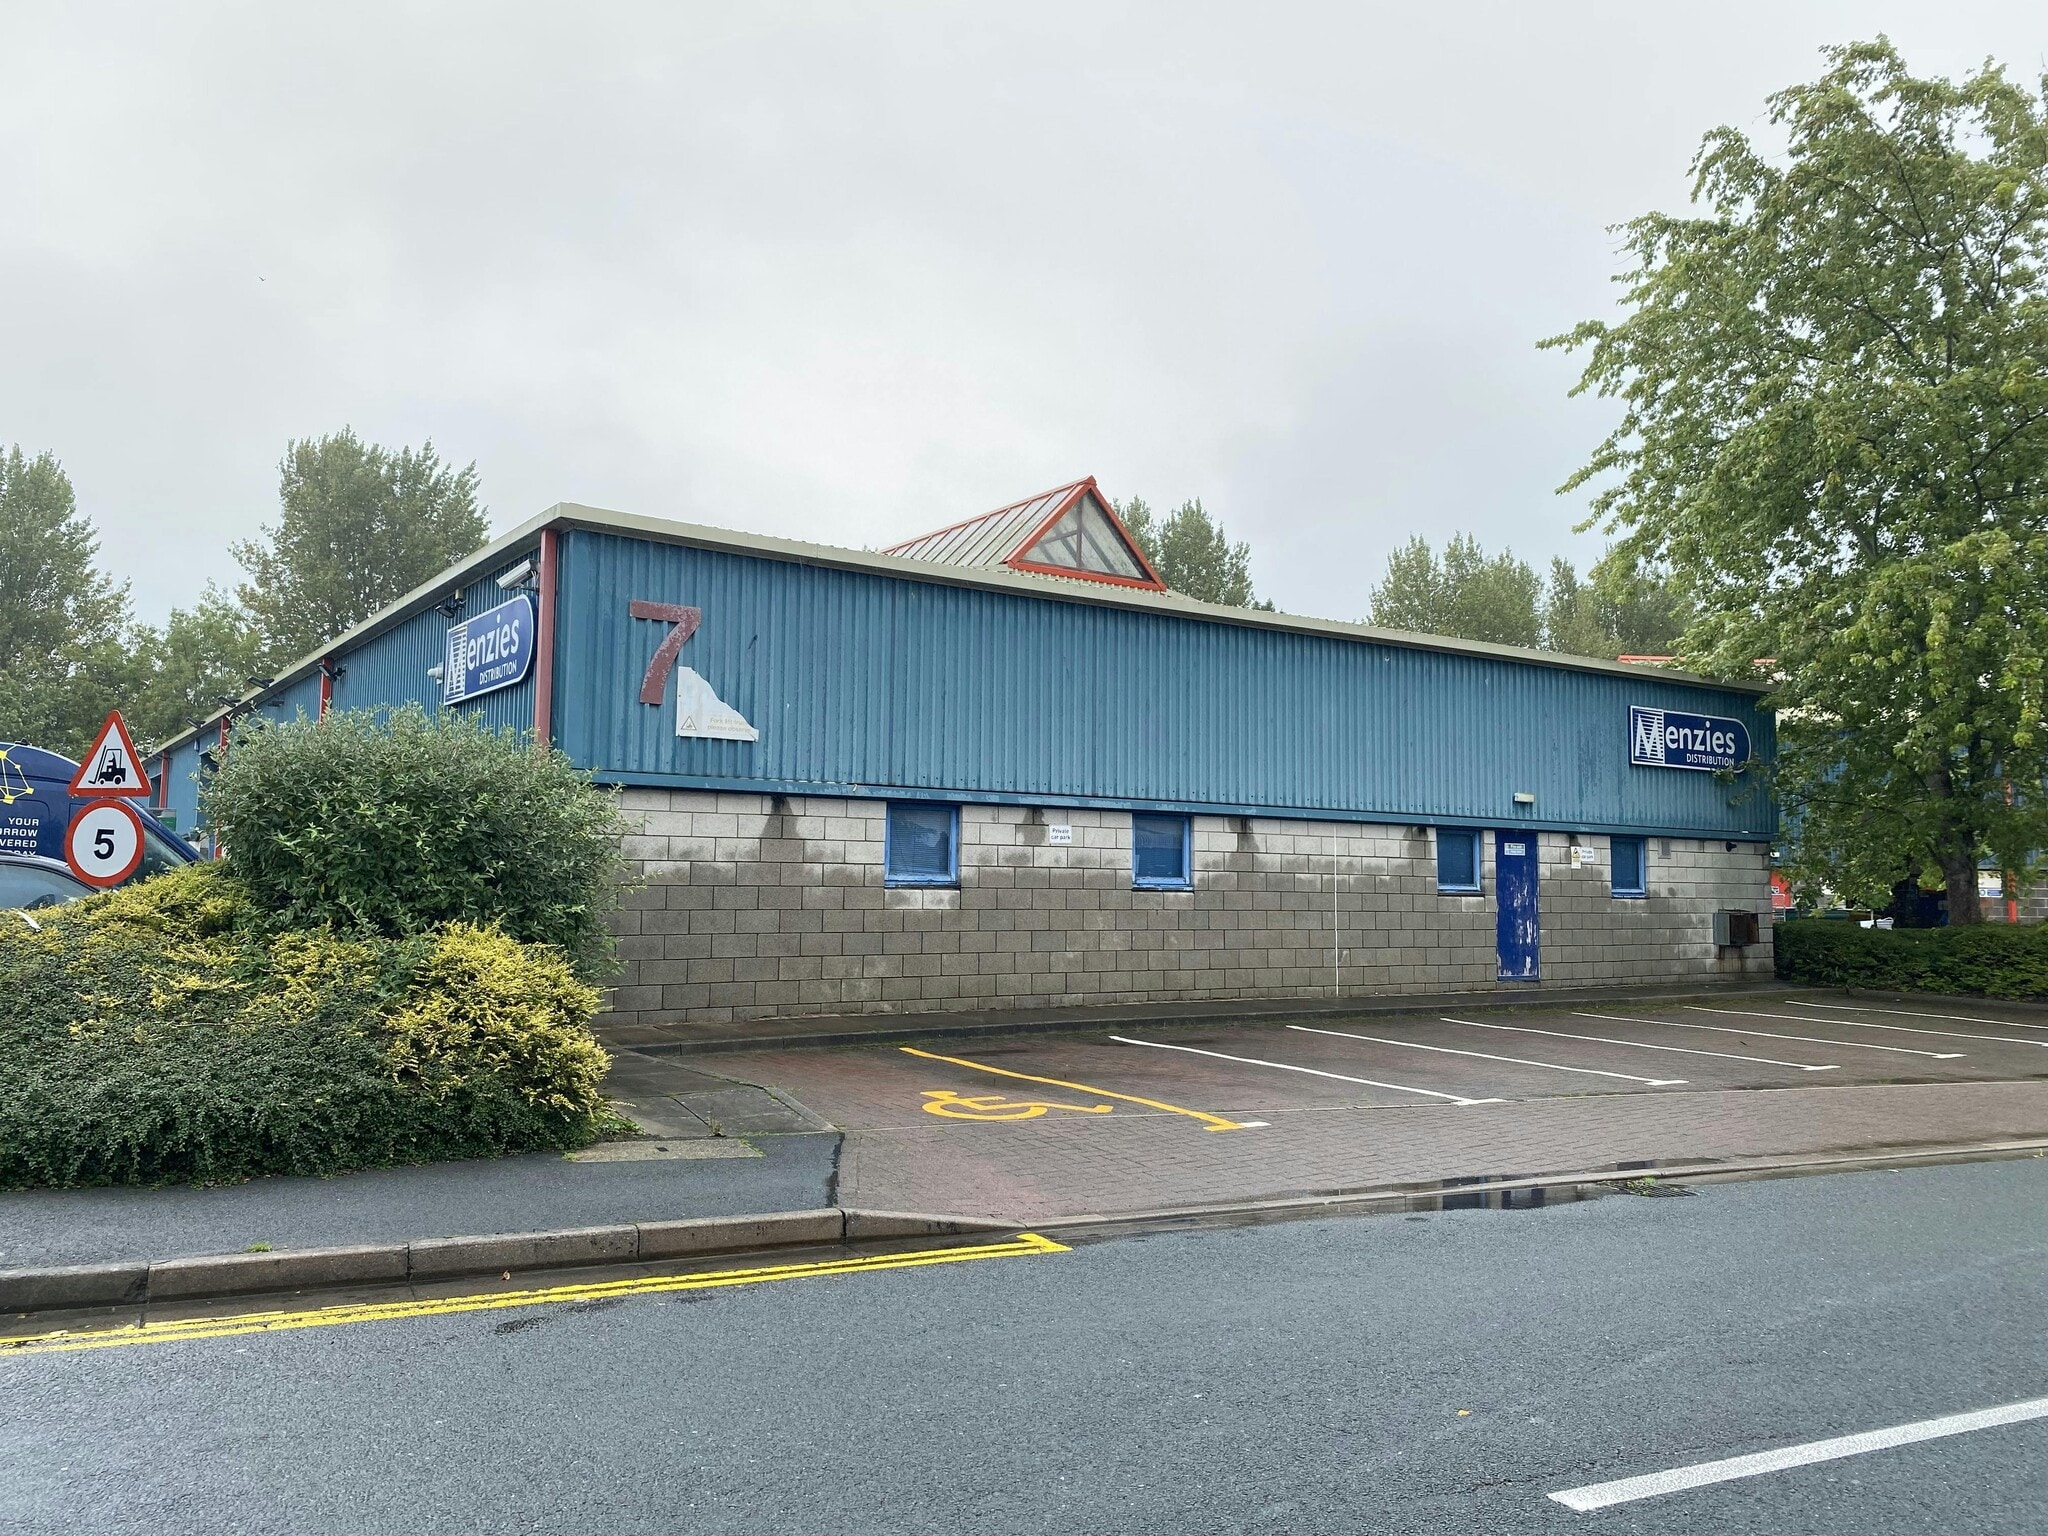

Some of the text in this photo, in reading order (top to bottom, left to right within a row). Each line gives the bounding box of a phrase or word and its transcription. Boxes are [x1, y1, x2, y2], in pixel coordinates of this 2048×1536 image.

[447, 613, 520, 695] Menzies
[630, 600, 701, 704] 7
[479, 660, 517, 685] DISTRIBUTION
[1635, 714, 1736, 758] Menzies
[1686, 753, 1735, 767] DISTRIBUTION
[8, 817, 39, 827] YOUR
[94, 829, 114, 860] 5
